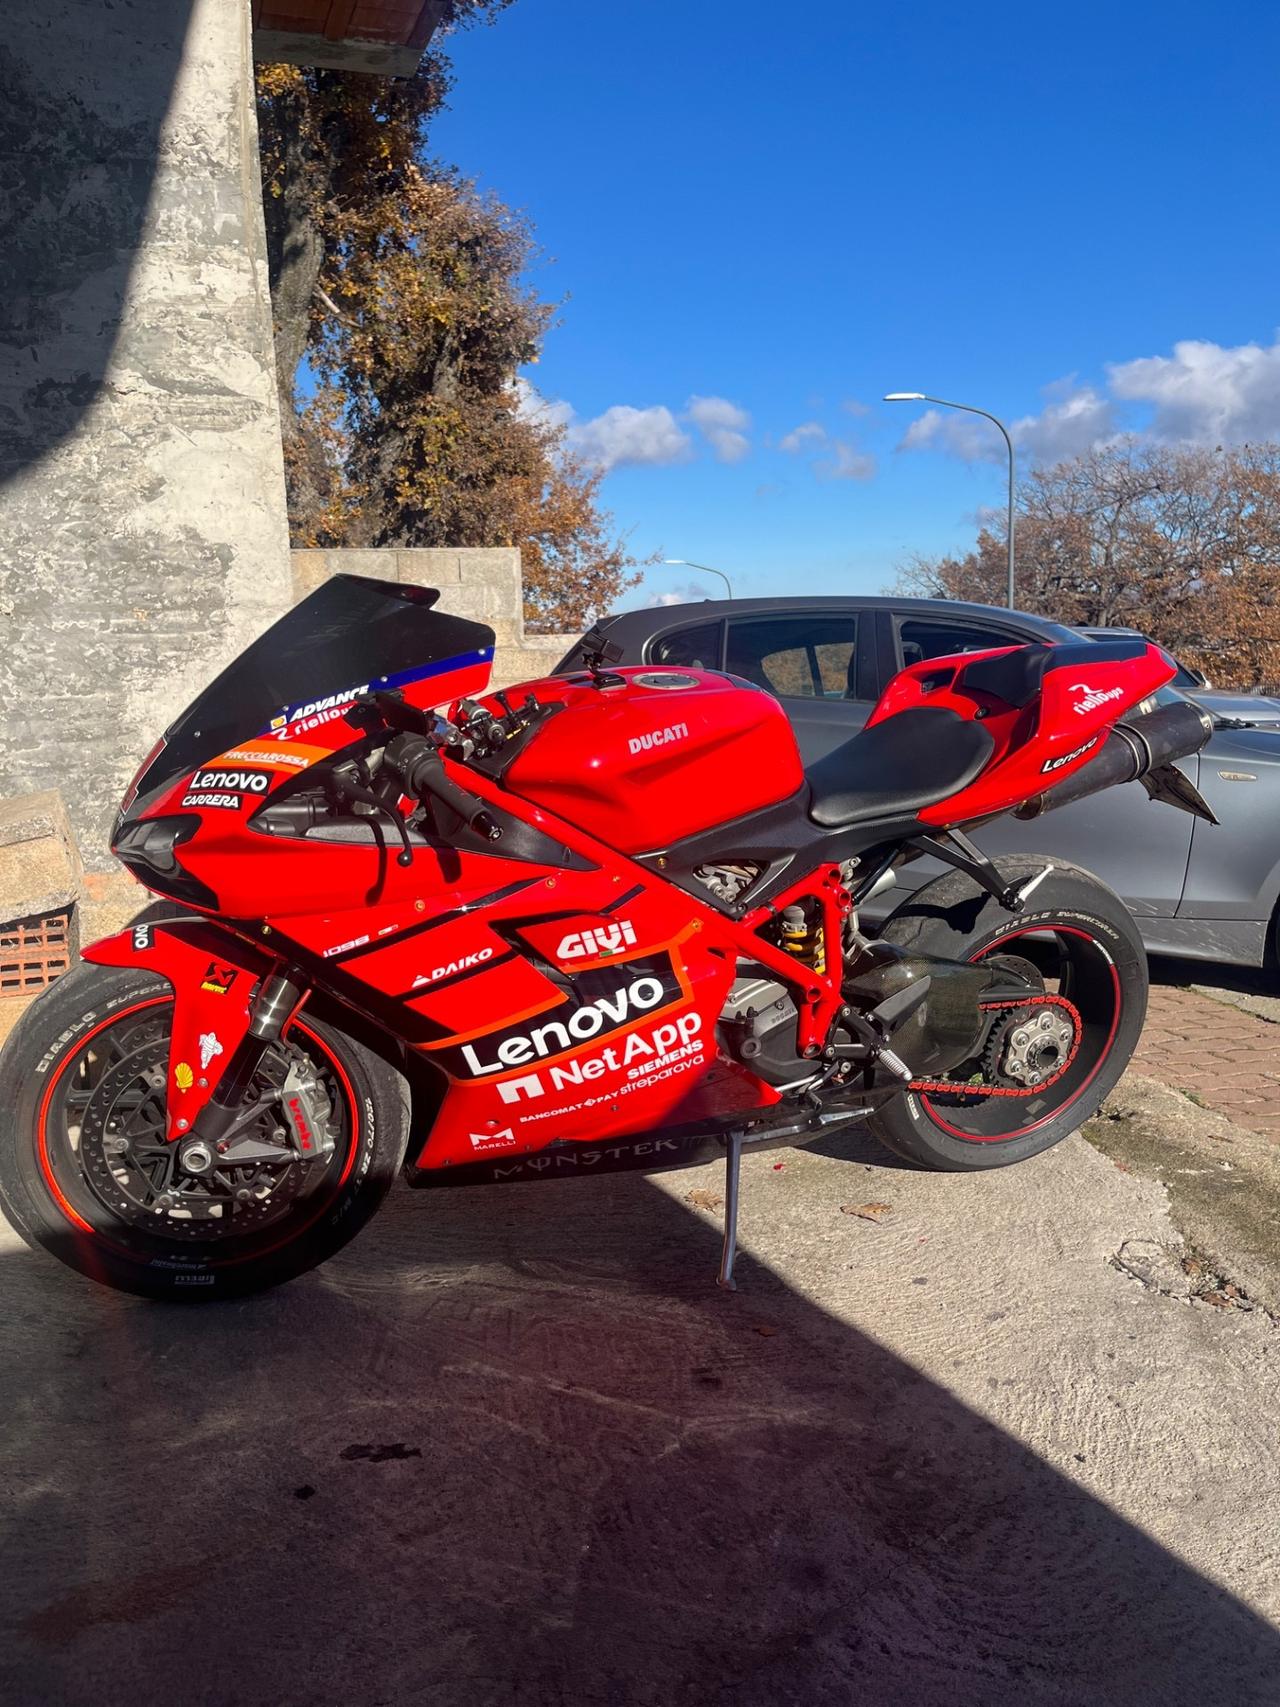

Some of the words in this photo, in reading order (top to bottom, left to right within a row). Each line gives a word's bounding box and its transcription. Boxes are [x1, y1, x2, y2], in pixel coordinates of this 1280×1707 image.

[289, 684, 370, 722] ADVANCE
[628, 722, 689, 755] DUCATI
[1041, 737, 1098, 773] Lenovo
[190, 770, 268, 792] Lenovo
[181, 794, 239, 808] CARRERA
[556, 920, 638, 960] GIVI
[995, 911, 1051, 936] DIABLO
[323, 934, 370, 958] 1098
[431, 947, 493, 980] DAIKO
[35, 1010, 97, 1073] DIABLO
[460, 977, 664, 1076] Lenovo
[549, 1012, 702, 1091] NetApp
[627, 1039, 704, 1080] SIEMENS
[620, 1053, 705, 1096] streparava
[519, 1102, 584, 1123] BANCOMAT
[596, 1091, 619, 1103] PAY
[473, 1140, 517, 1151] MARELLI
